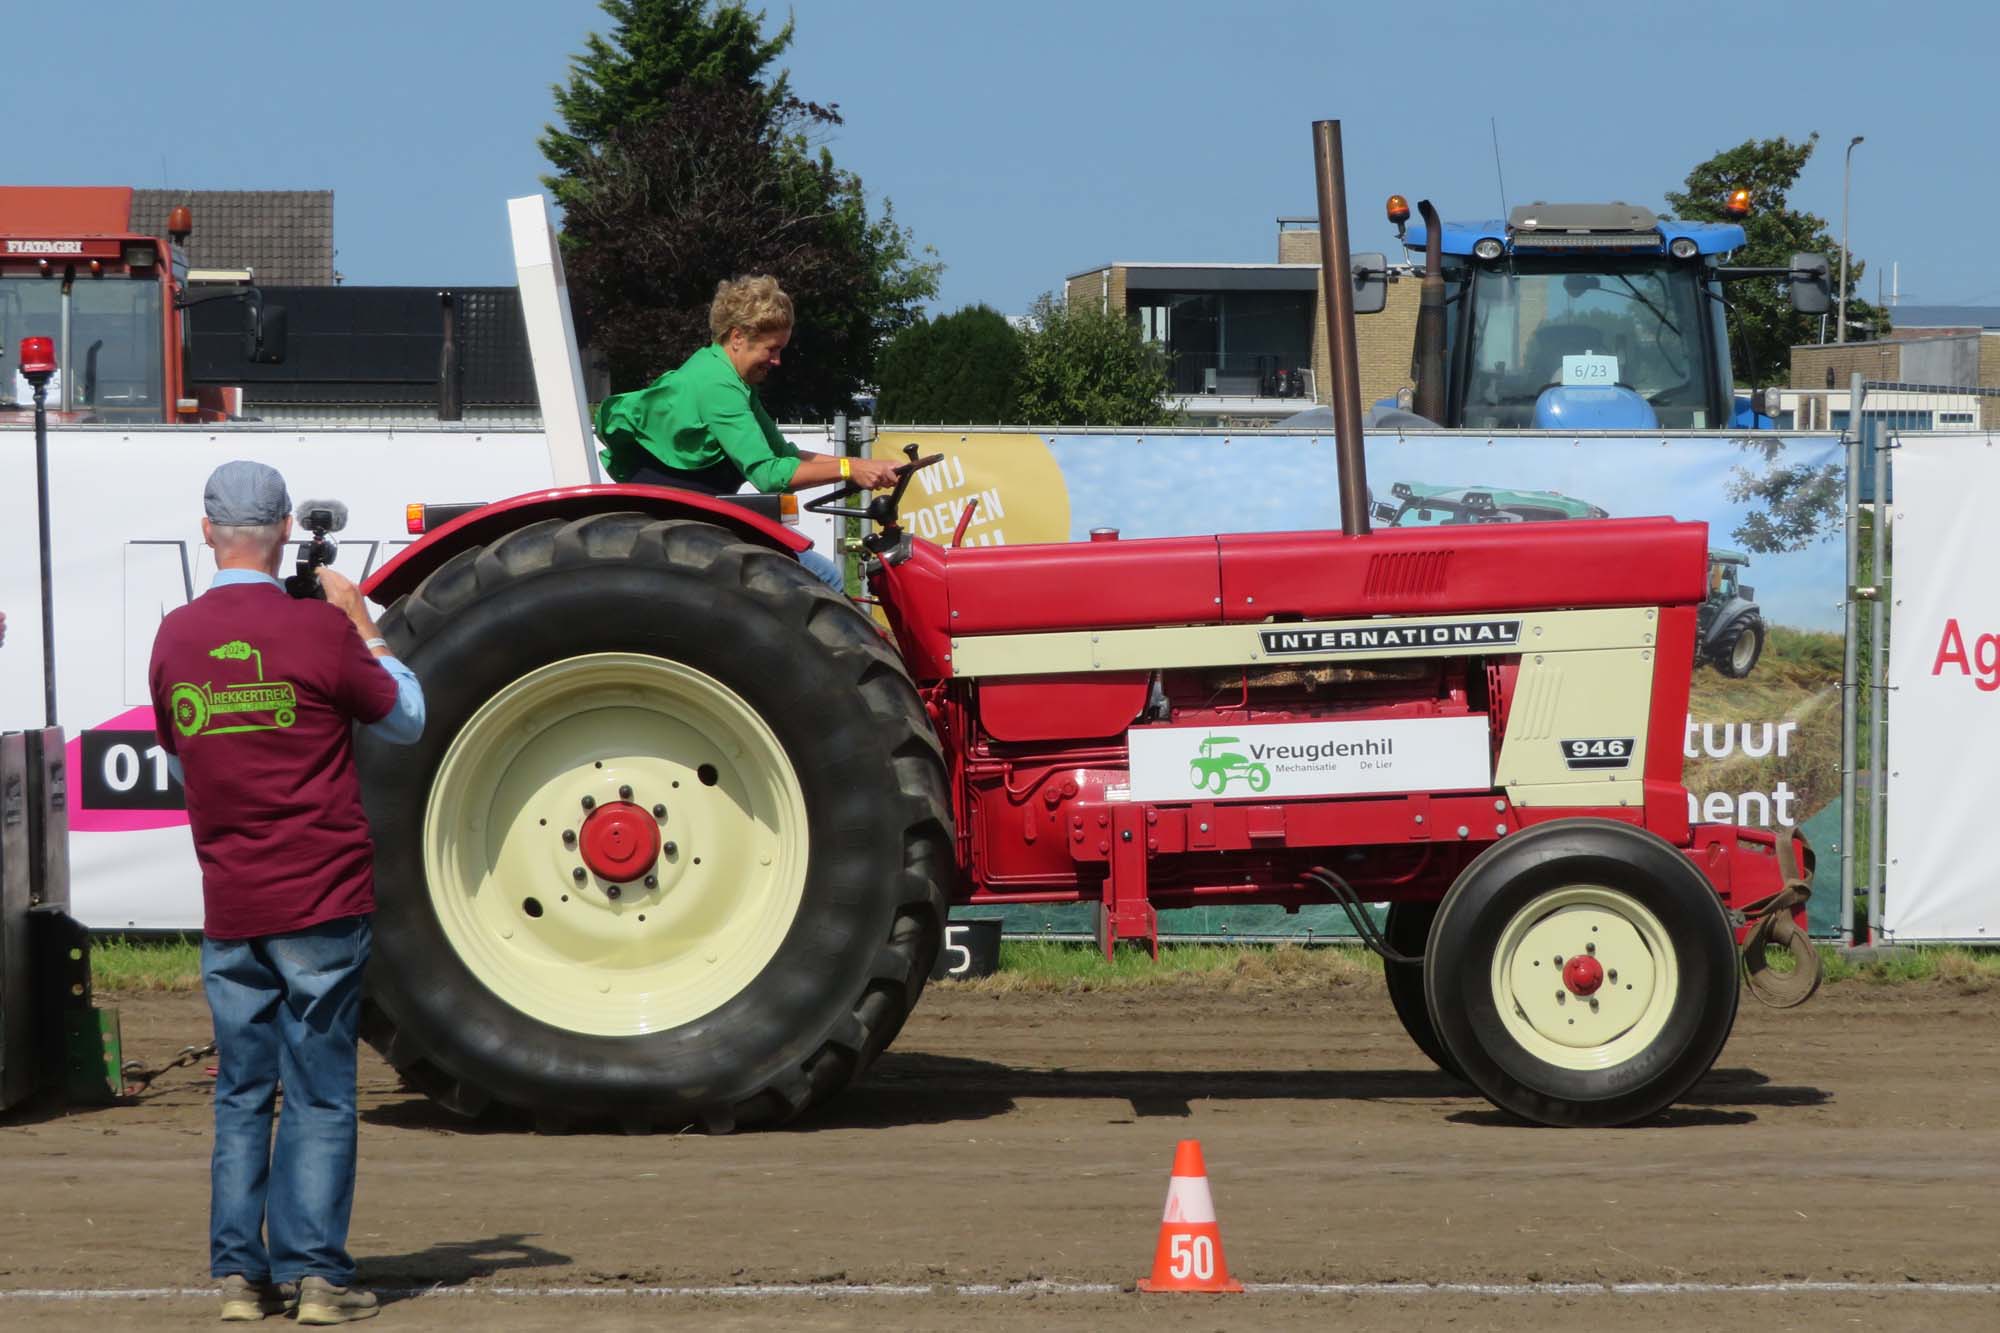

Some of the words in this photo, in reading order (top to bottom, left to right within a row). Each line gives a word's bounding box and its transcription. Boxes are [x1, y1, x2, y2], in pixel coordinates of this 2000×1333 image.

[7, 240, 83, 254] FIATAGRI
[1574, 364, 1608, 380] 6/23
[916, 456, 965, 496] WIJ
[903, 487, 1005, 540] ZOEKEN
[1269, 624, 1514, 649] INTERNATIONAL
[1931, 618, 2000, 692] Ag
[1250, 739, 1393, 762] Vreugdenhil
[1571, 740, 1626, 757] 946
[104, 743, 169, 791] 01
[1275, 763, 1337, 773] Mechanisatie
[1360, 762, 1373, 771] De
[1377, 759, 1393, 770] Lier
[945, 926, 970, 973] 5
[1170, 1234, 1214, 1280] 50
